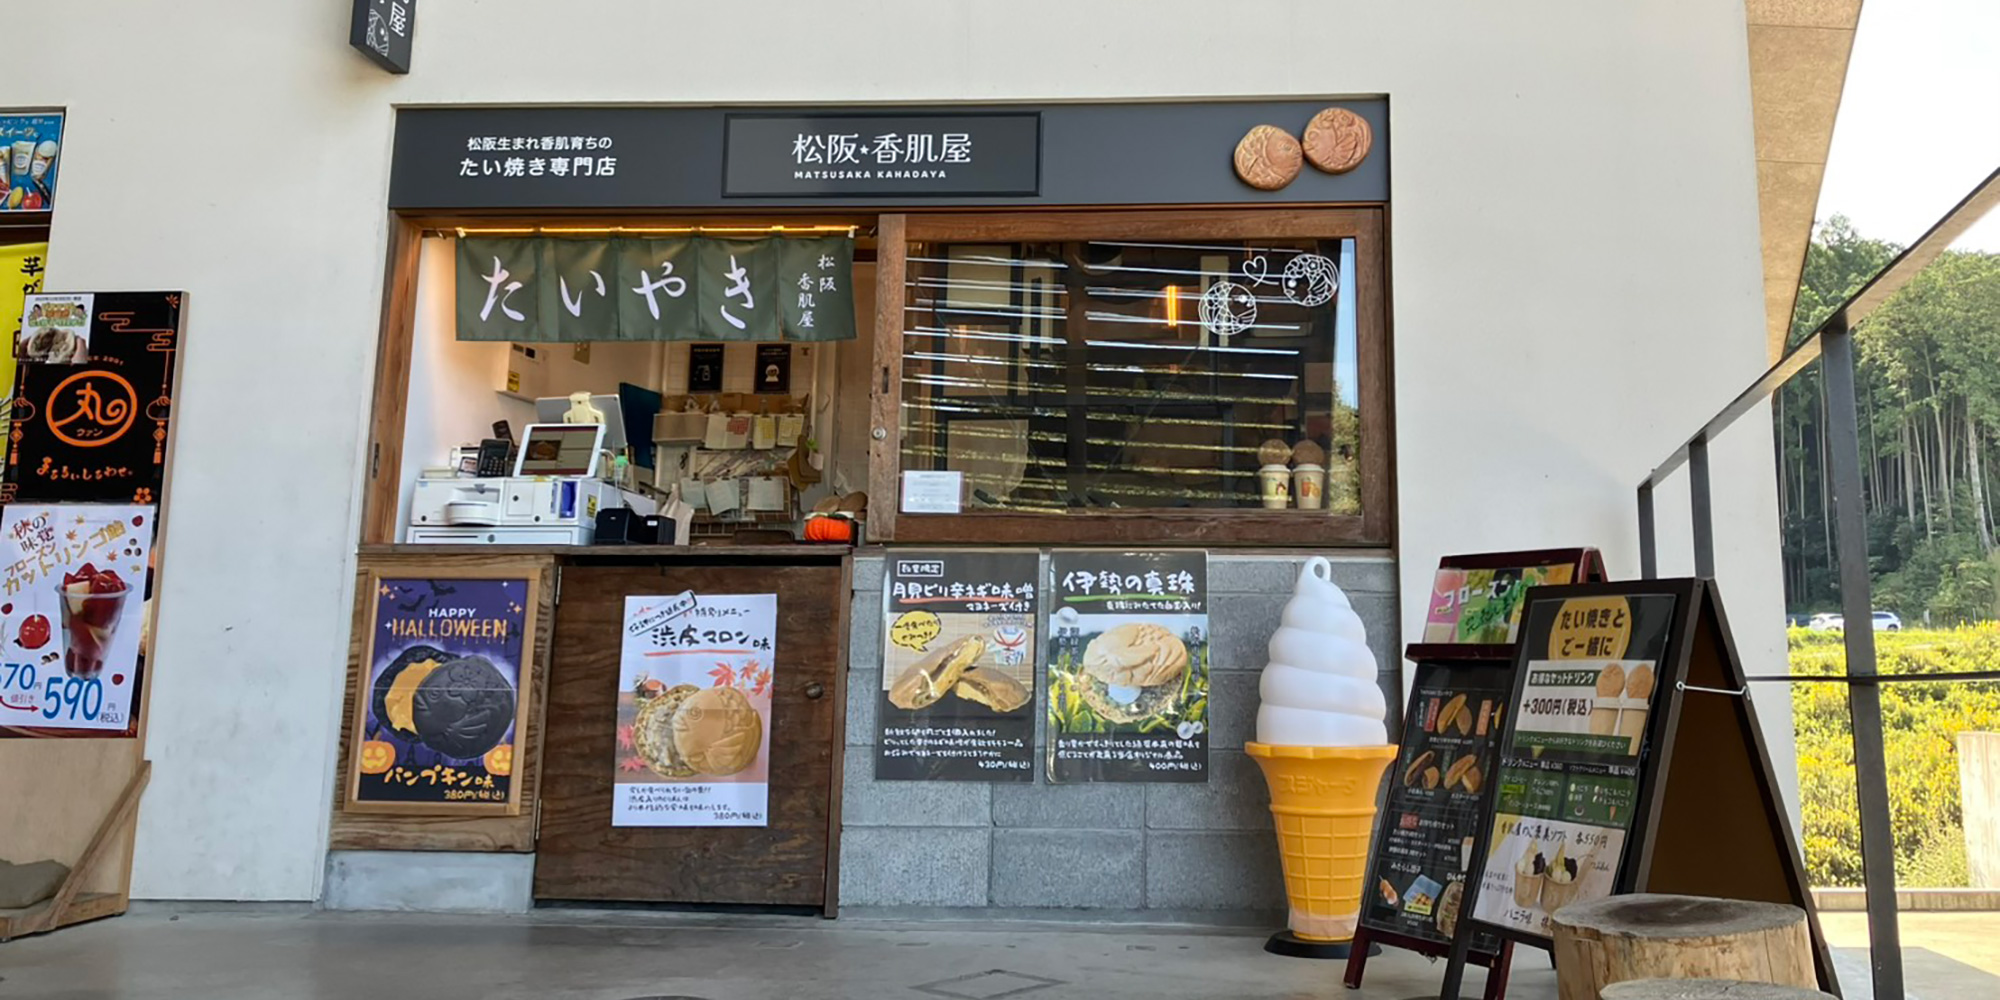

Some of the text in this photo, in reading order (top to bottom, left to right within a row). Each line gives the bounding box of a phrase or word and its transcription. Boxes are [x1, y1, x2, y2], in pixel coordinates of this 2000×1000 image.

[467, 136, 613, 150] 松阪生まれ香肌育ちの
[459, 157, 617, 177] たい焼き専門店
[794, 170, 946, 180] MATSUSAKA KAHADAYA
[817, 254, 836, 293] 松阪
[479, 254, 756, 330] たいやき
[797, 272, 816, 328] 香肌屋
[13, 515, 48, 539] 秋の
[20, 526, 55, 553] 味覚
[4, 541, 57, 577] フローズン
[893, 581, 1034, 599] 月見ピリ辛ネギ味噌
[1062, 570, 1196, 596] 伊勢の真珠
[428, 608, 476, 618] HAPPY
[966, 602, 1031, 612] マヨネーズ付き
[391, 617, 508, 640] HALLOWEEN
[1560, 609, 1625, 630] たい焼きと
[651, 624, 771, 651] 渋皮マロン味
[1561, 636, 1614, 656] ご一緒に
[384, 764, 495, 788] パンプキン味
[444, 789, 506, 800] 380円(税込)
